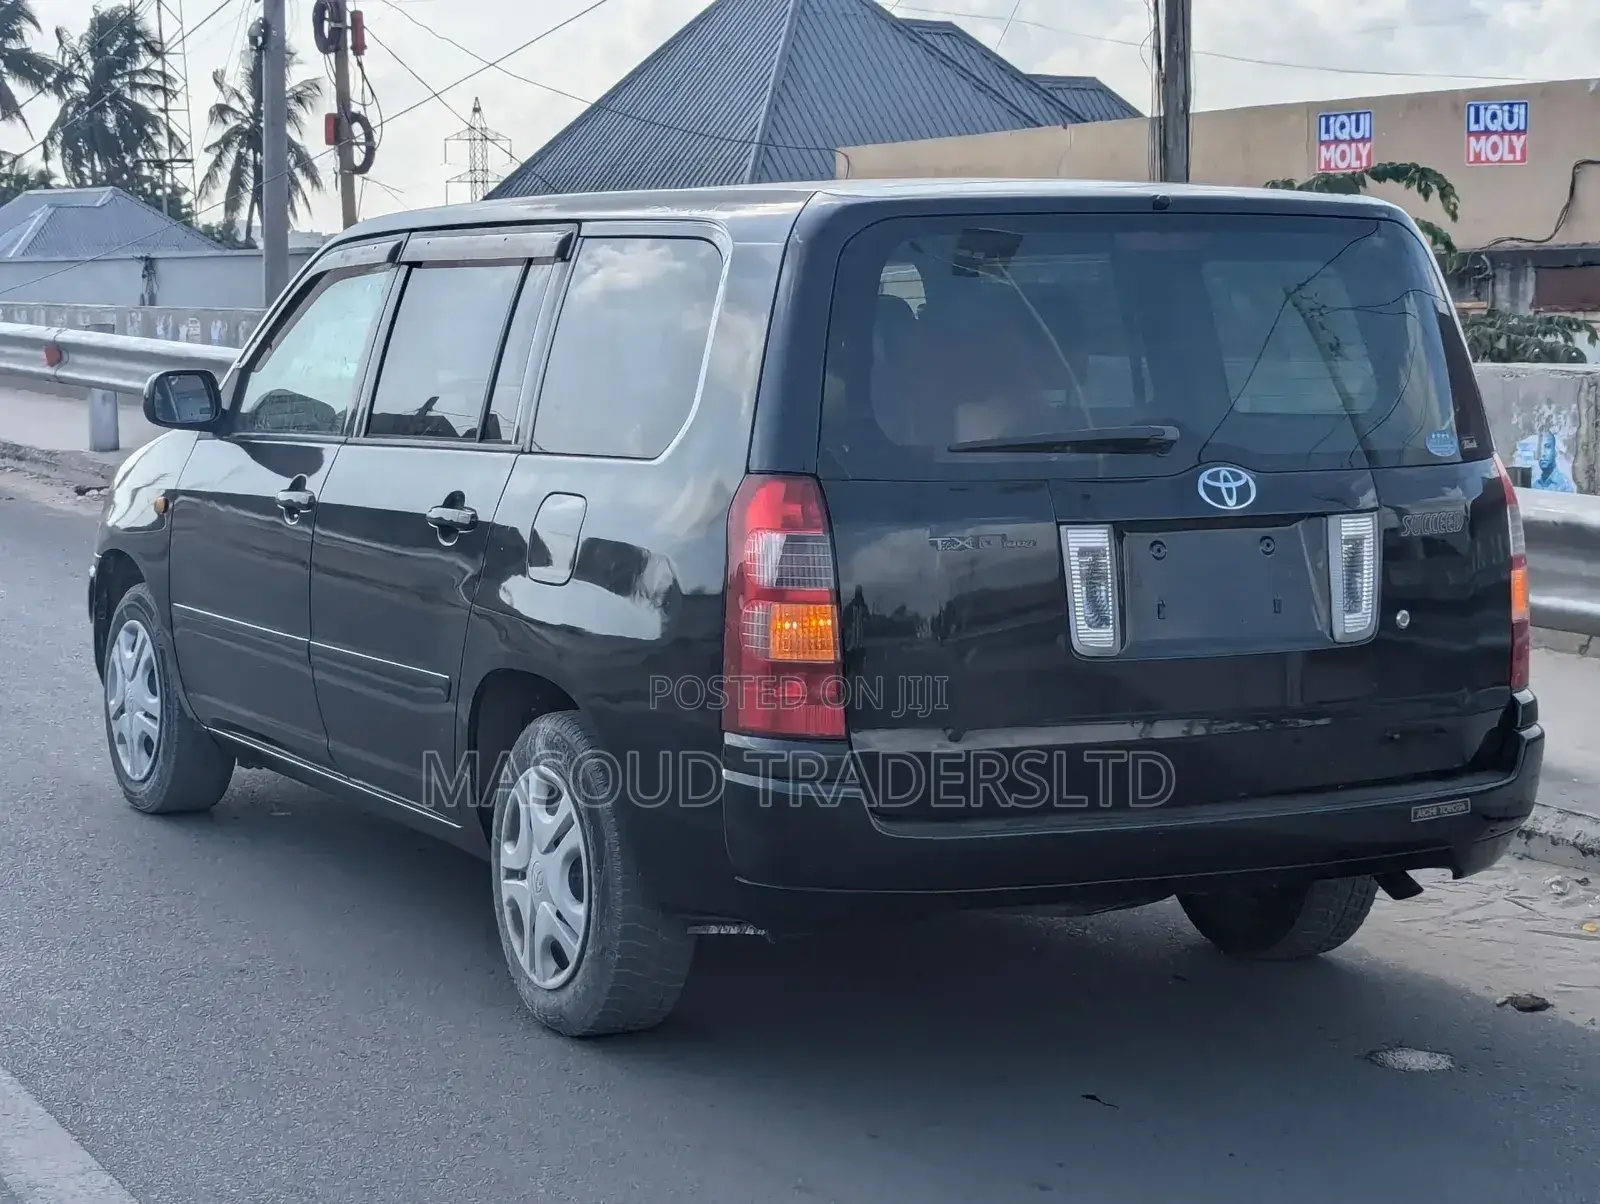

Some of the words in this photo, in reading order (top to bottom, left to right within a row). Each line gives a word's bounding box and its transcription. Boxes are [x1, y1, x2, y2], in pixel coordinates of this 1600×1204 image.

[1320, 113, 1371, 142] LIQUI
[1468, 103, 1526, 132] LIQUI
[1320, 142, 1371, 170] MOLY
[1468, 134, 1526, 163] MOLY
[1401, 510, 1464, 537] SUCCEED
